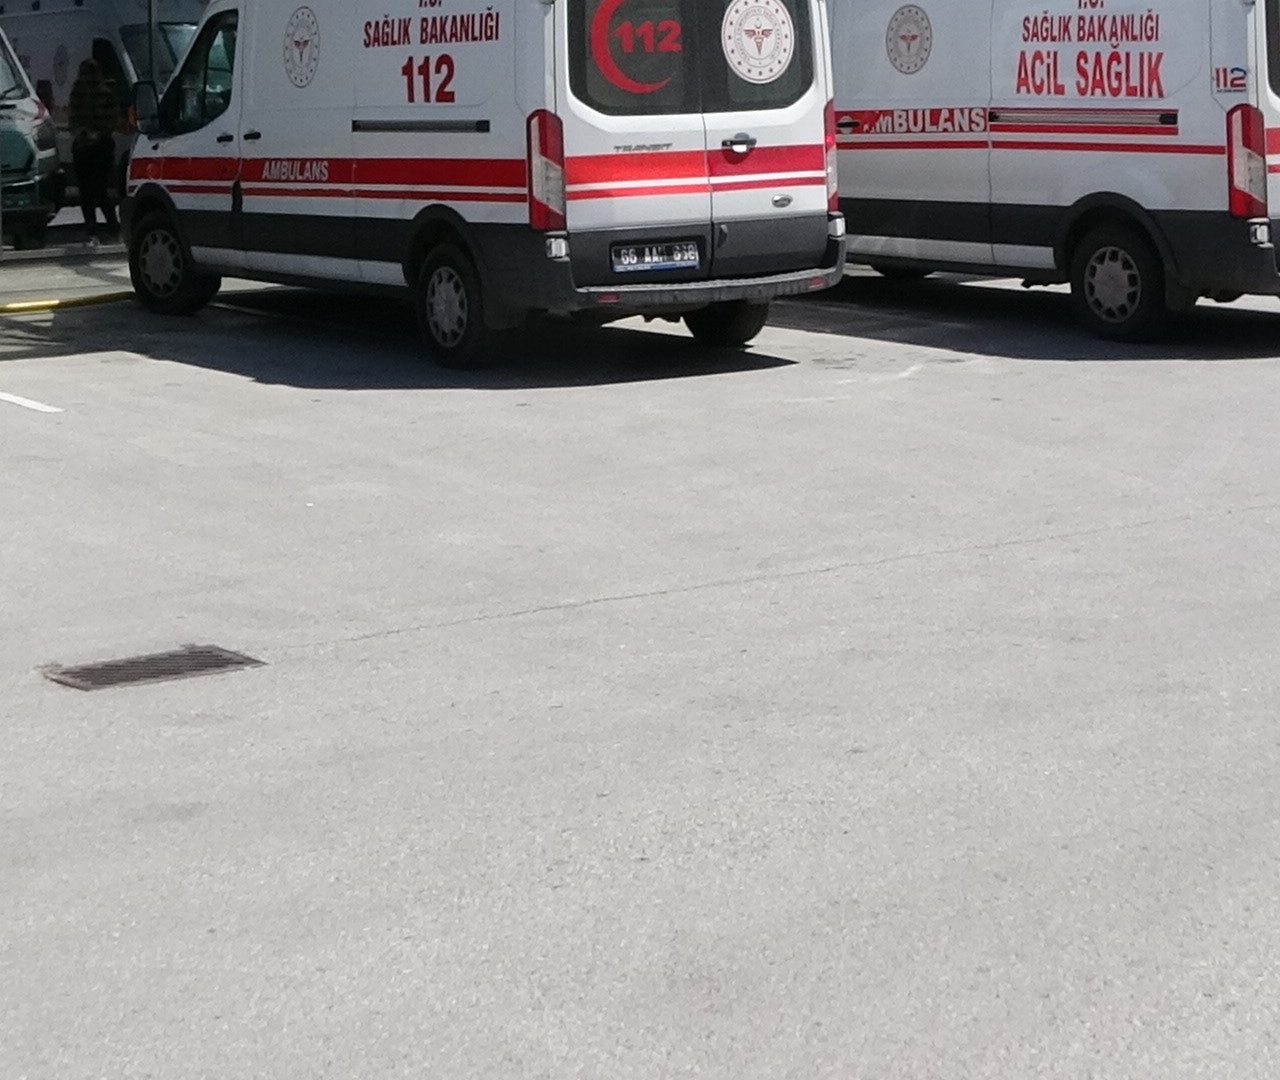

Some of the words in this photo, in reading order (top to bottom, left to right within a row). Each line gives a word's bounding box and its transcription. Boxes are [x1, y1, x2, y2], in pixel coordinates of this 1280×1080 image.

[363, 13, 412, 48] SAĞLIK
[419, 5, 500, 45] BAKANLIĞI
[614, 18, 683, 54] 112
[1022, 10, 1072, 43] SAĞLIK
[1076, 8, 1159, 42] BAKANLIĞI
[401, 53, 456, 103] 112
[1075, 42, 1164, 99] SAĞLIK
[1214, 66, 1247, 88] 112
[261, 160, 329, 182] AMBULANS
